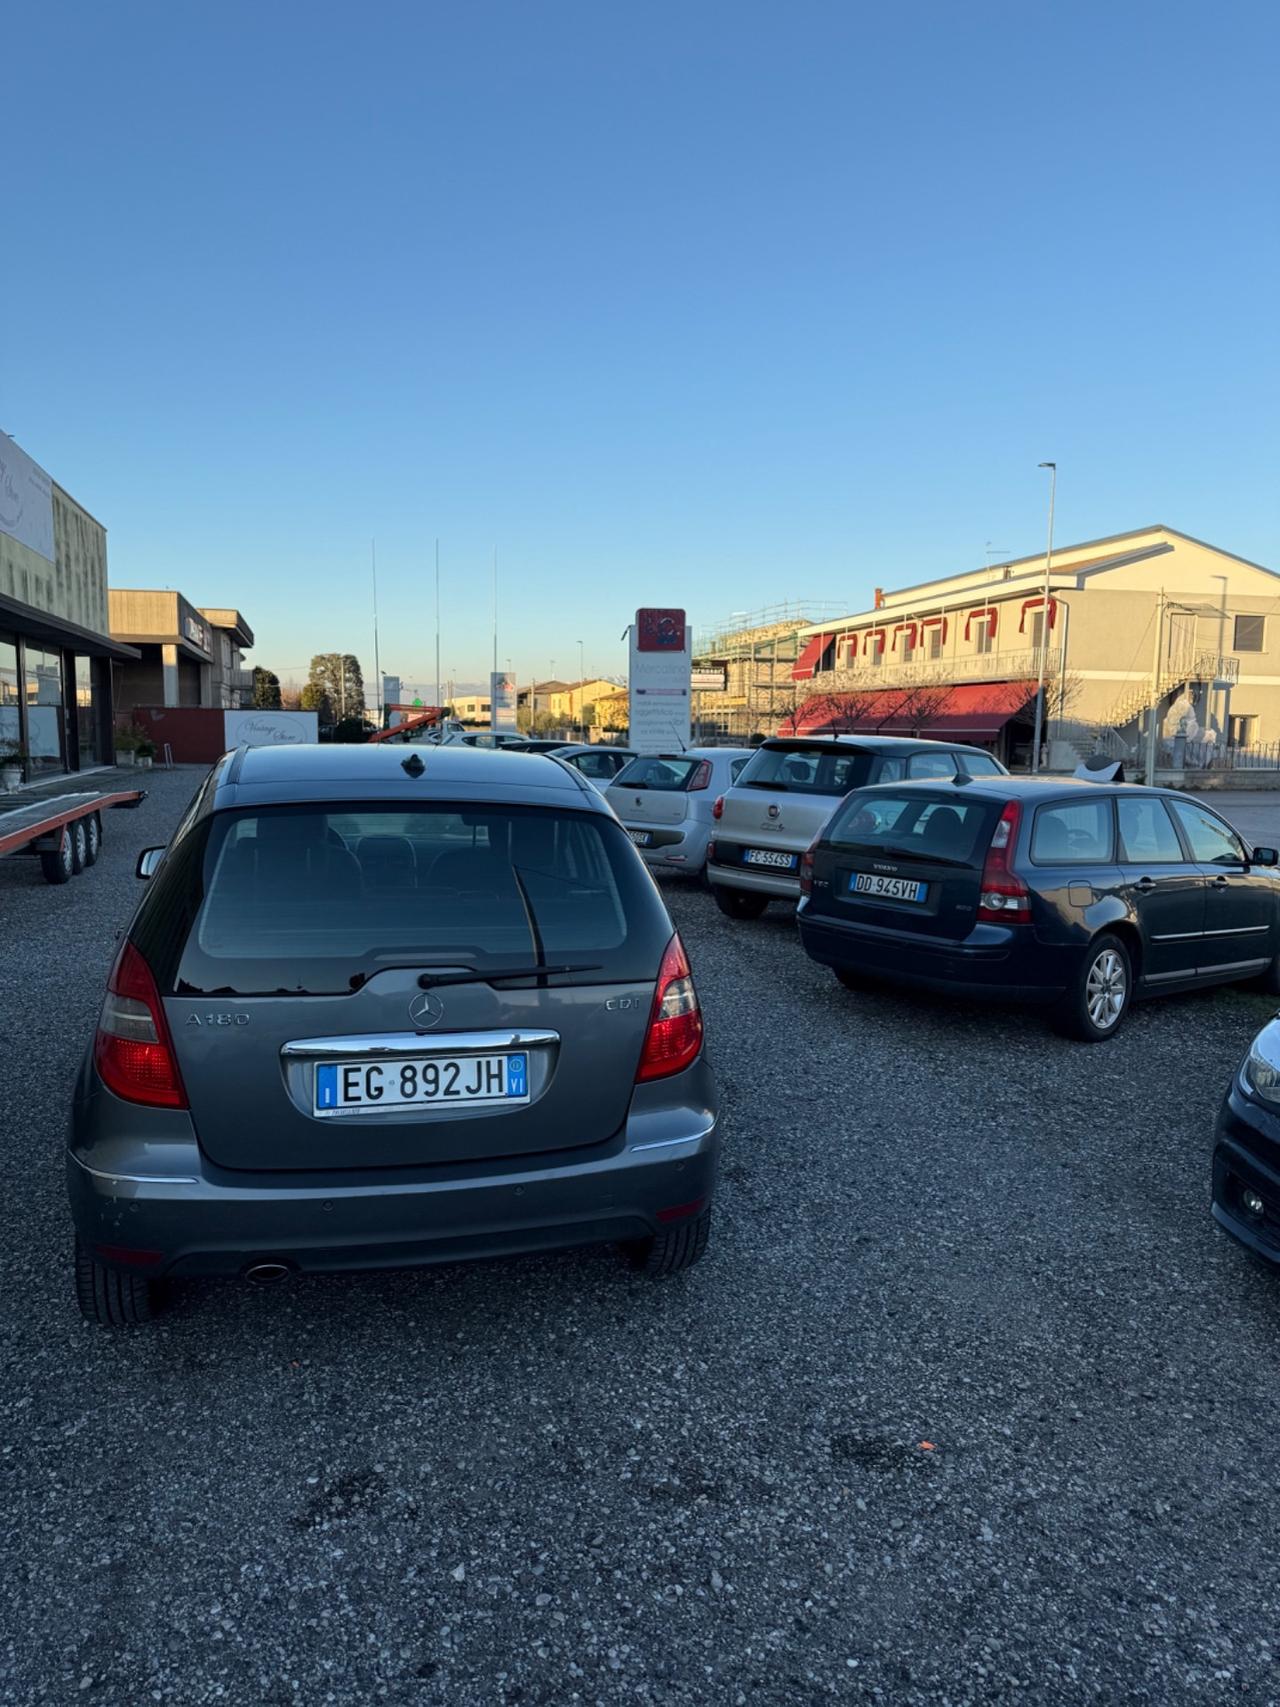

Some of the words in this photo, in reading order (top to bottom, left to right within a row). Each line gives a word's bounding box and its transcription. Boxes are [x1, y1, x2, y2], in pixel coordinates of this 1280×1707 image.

[856, 875, 872, 892] DD
[876, 878, 919, 899] 945VH
[606, 998, 640, 1010] CDI
[343, 1065, 384, 1102] EG
[400, 1059, 505, 1099] 892JH
[510, 1078, 523, 1093] VI
